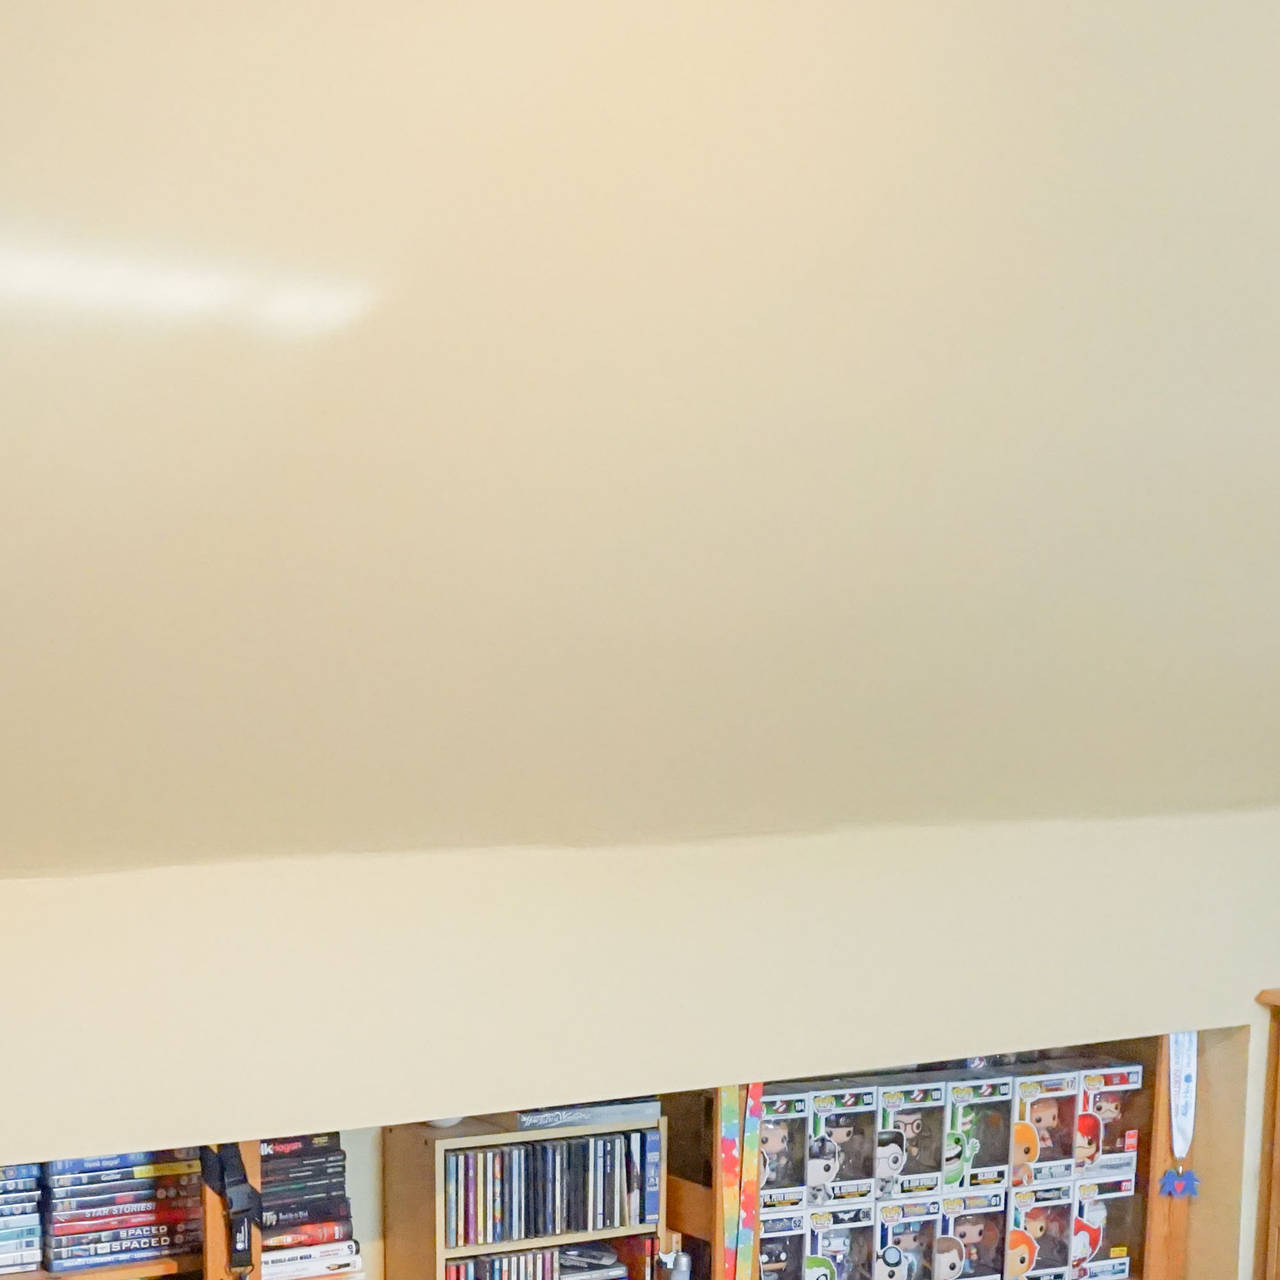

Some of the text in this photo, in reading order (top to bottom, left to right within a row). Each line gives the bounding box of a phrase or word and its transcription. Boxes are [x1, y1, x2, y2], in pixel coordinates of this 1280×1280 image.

[85, 1208, 110, 1218] STAR
[120, 1225, 168, 1238] SPACED
[109, 1237, 170, 1251] SPACED
